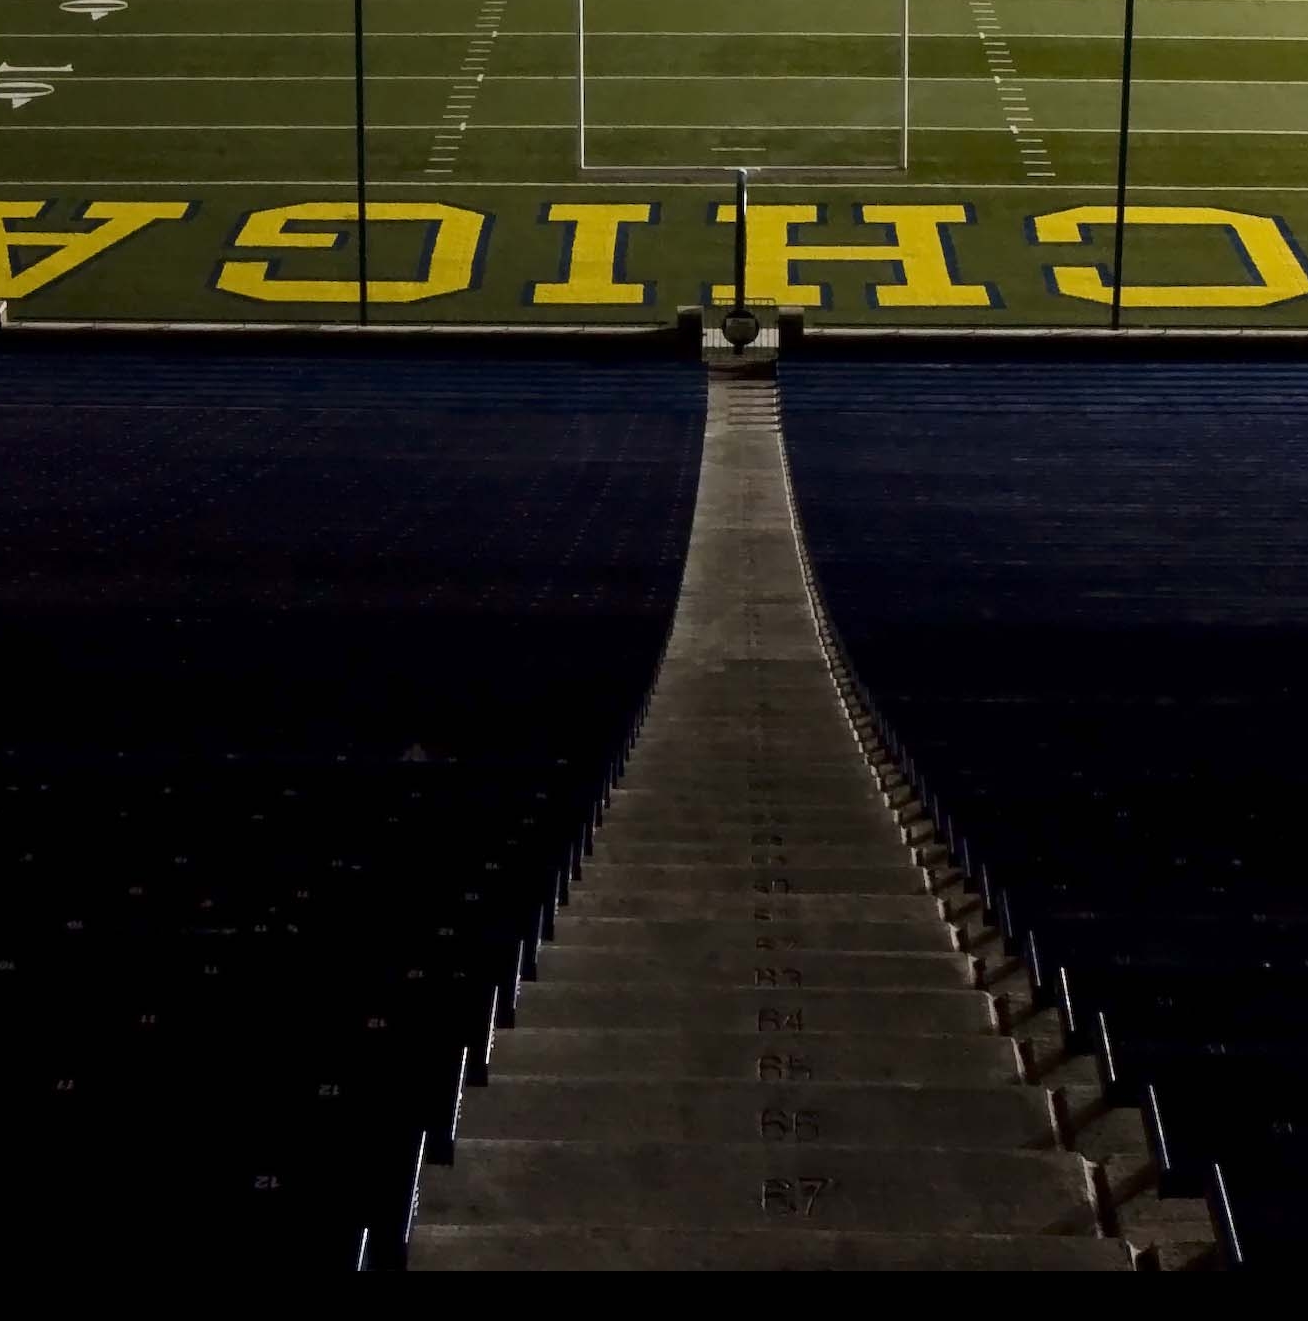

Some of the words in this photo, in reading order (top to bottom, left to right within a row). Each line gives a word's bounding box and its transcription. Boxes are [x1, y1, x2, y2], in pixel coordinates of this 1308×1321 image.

[757, 1008, 804, 1032] 64
[757, 1055, 812, 1080] 65
[760, 1109, 820, 1142] 66
[253, 1175, 280, 1189] 12
[760, 1178, 834, 1217] 67
